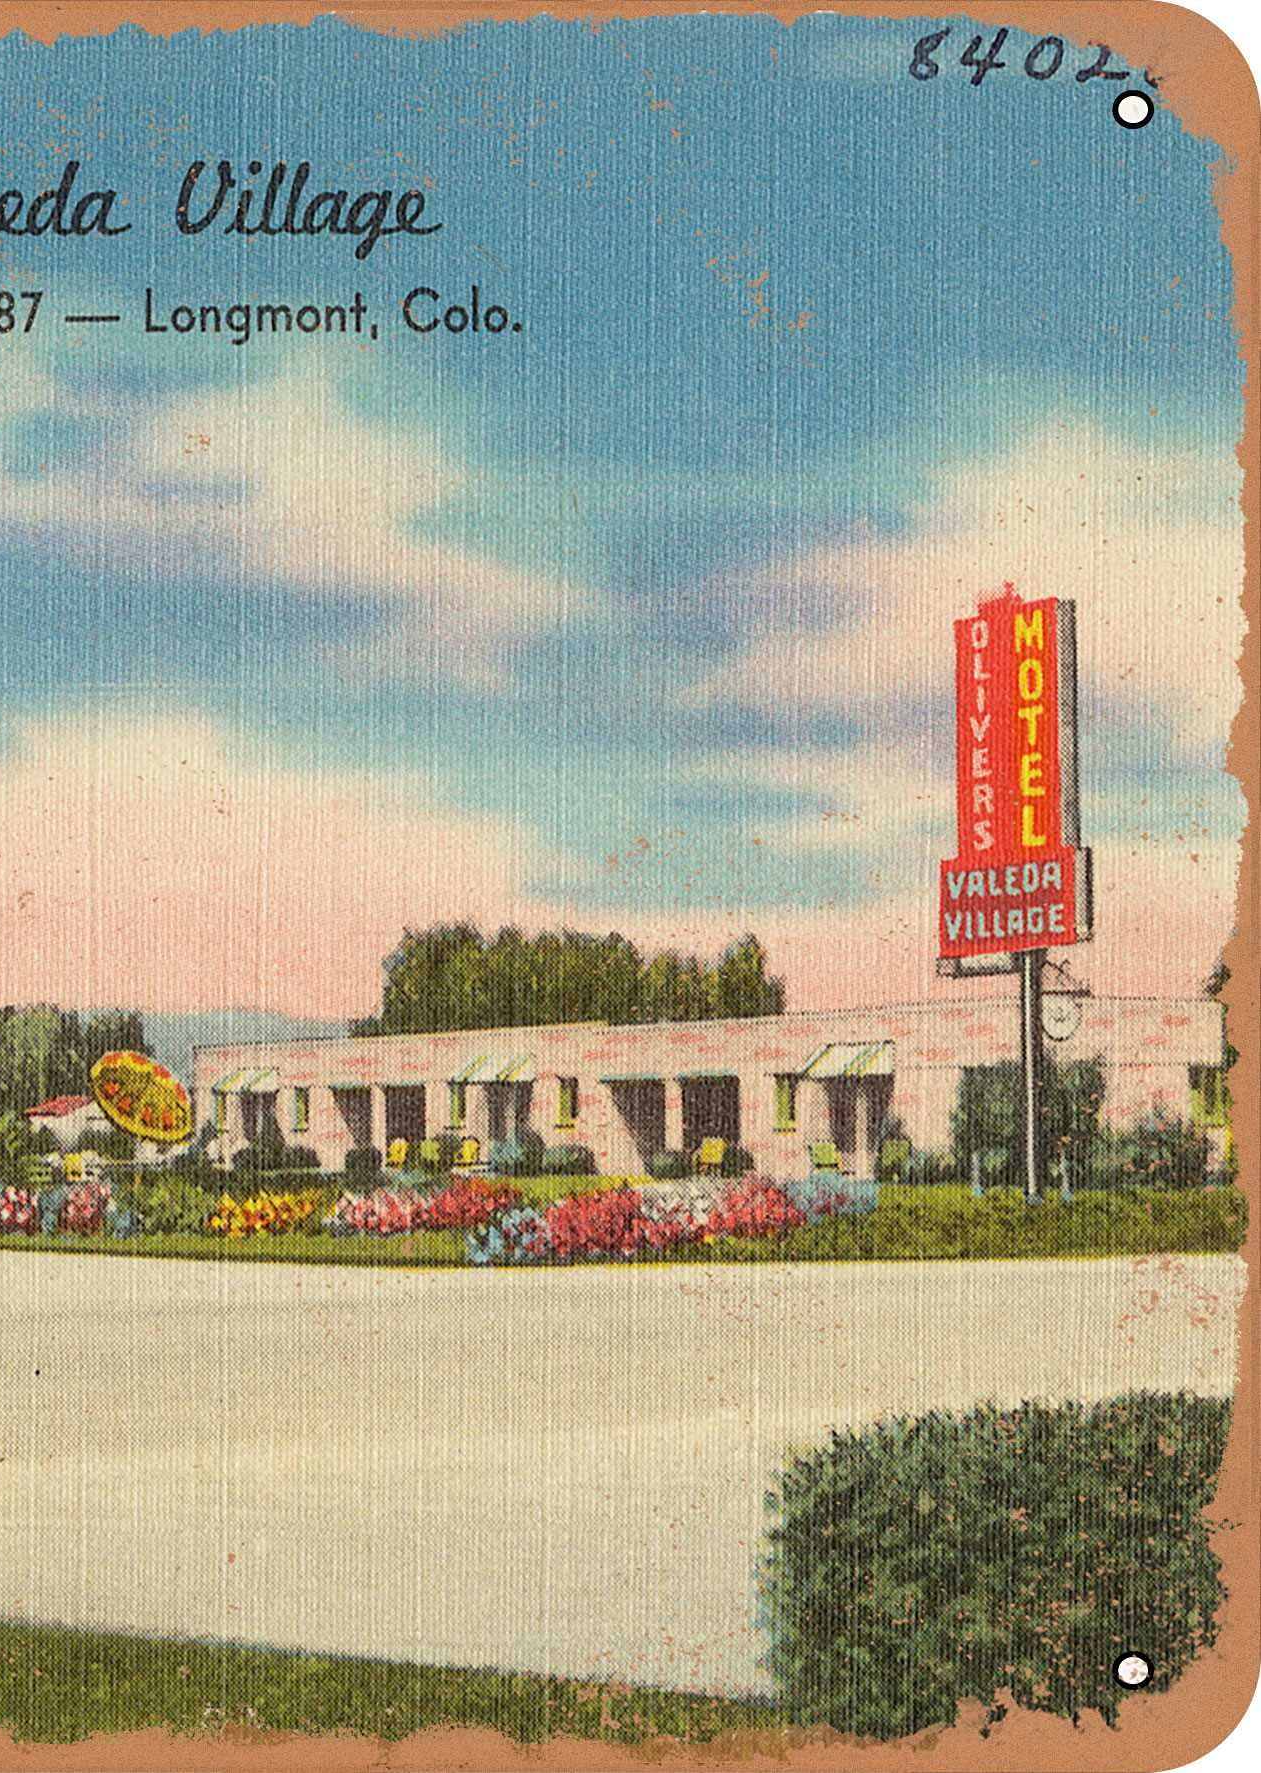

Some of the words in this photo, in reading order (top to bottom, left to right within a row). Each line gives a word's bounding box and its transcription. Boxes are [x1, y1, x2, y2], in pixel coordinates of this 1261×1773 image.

[969, 619, 995, 851] OLIVERS
[1014, 609, 1046, 847] MOTEL
[944, 903, 1066, 941] VILLAGE
[946, 861, 1063, 900] VALEDA
